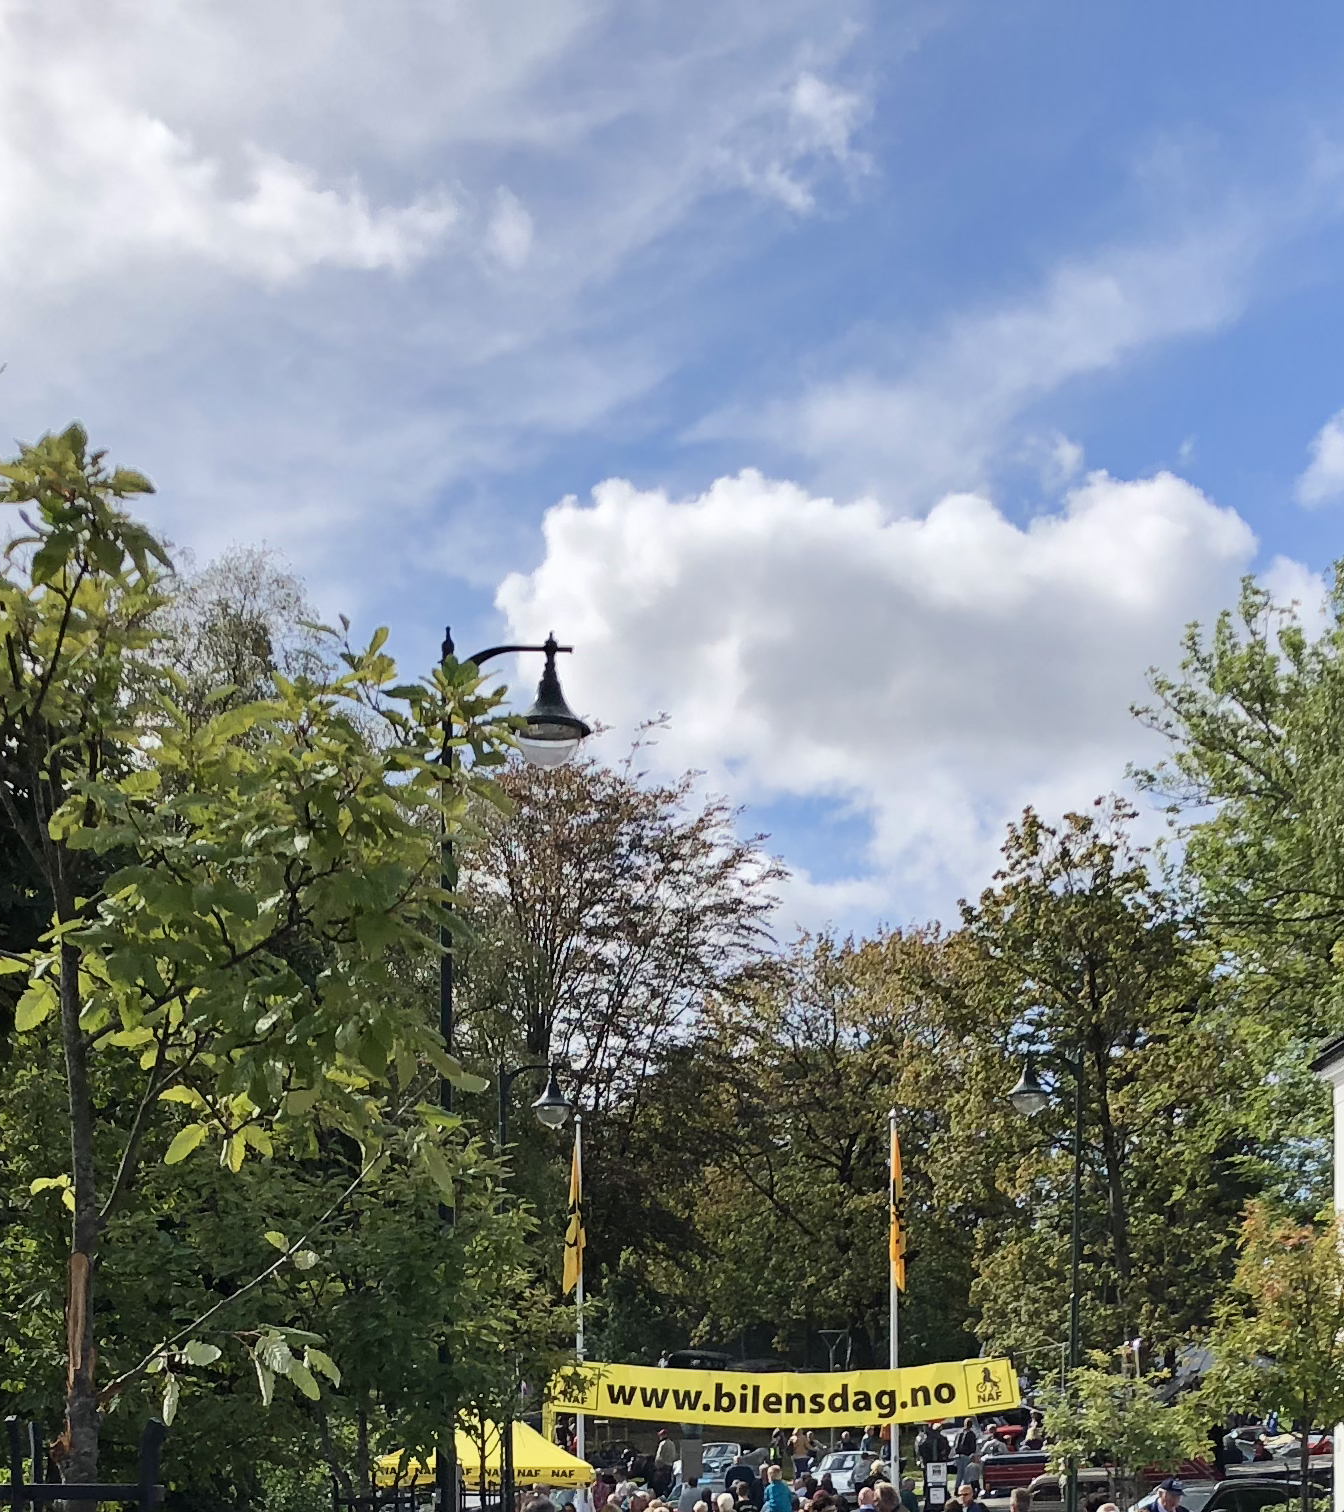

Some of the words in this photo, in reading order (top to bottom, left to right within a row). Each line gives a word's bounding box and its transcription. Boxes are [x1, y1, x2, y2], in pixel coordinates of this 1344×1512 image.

[606, 1382, 956, 1419] www.bilensdag.no
[977, 1390, 1003, 1404] NAF
[517, 1468, 541, 1478] NAF
[551, 1469, 576, 1479] NAF
